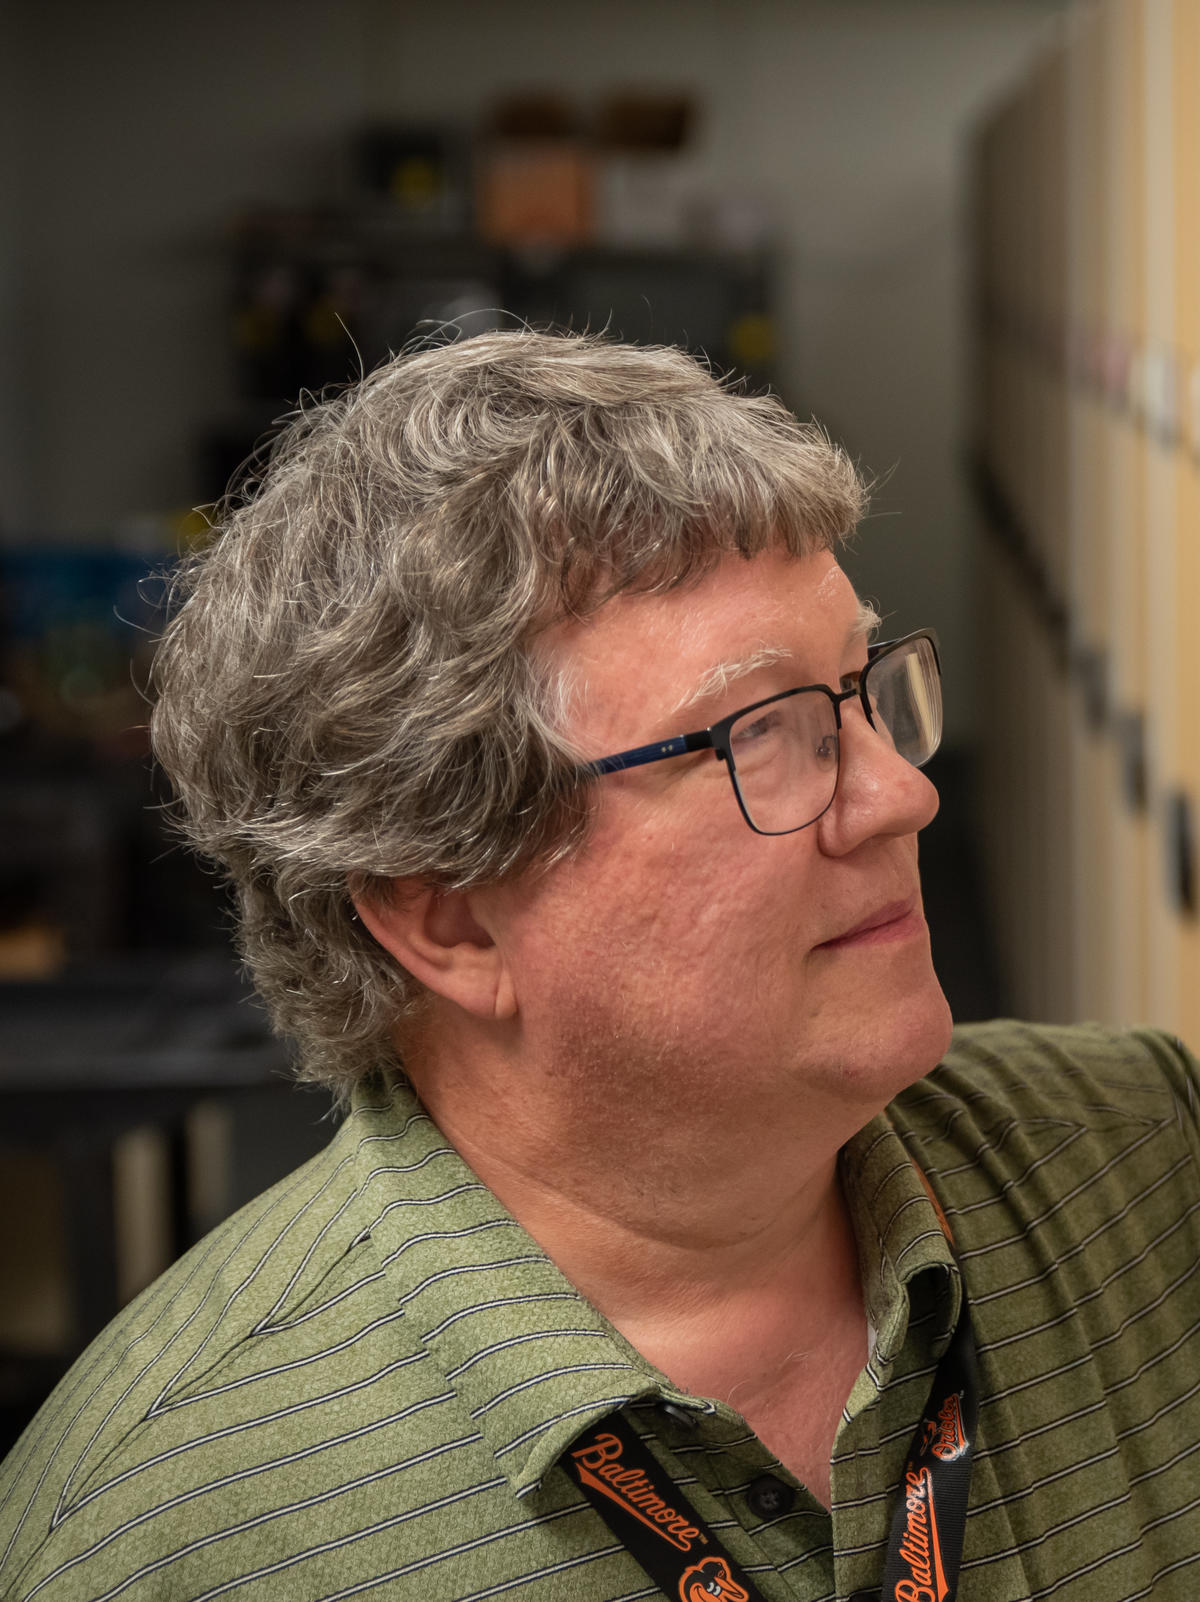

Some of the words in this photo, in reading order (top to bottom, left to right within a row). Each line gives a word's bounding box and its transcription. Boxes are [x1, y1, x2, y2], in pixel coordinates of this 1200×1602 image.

[931, 1393, 966, 1462] Orioles
[571, 1433, 699, 1551] Baltimore
[895, 1467, 940, 1602] Baltimore
